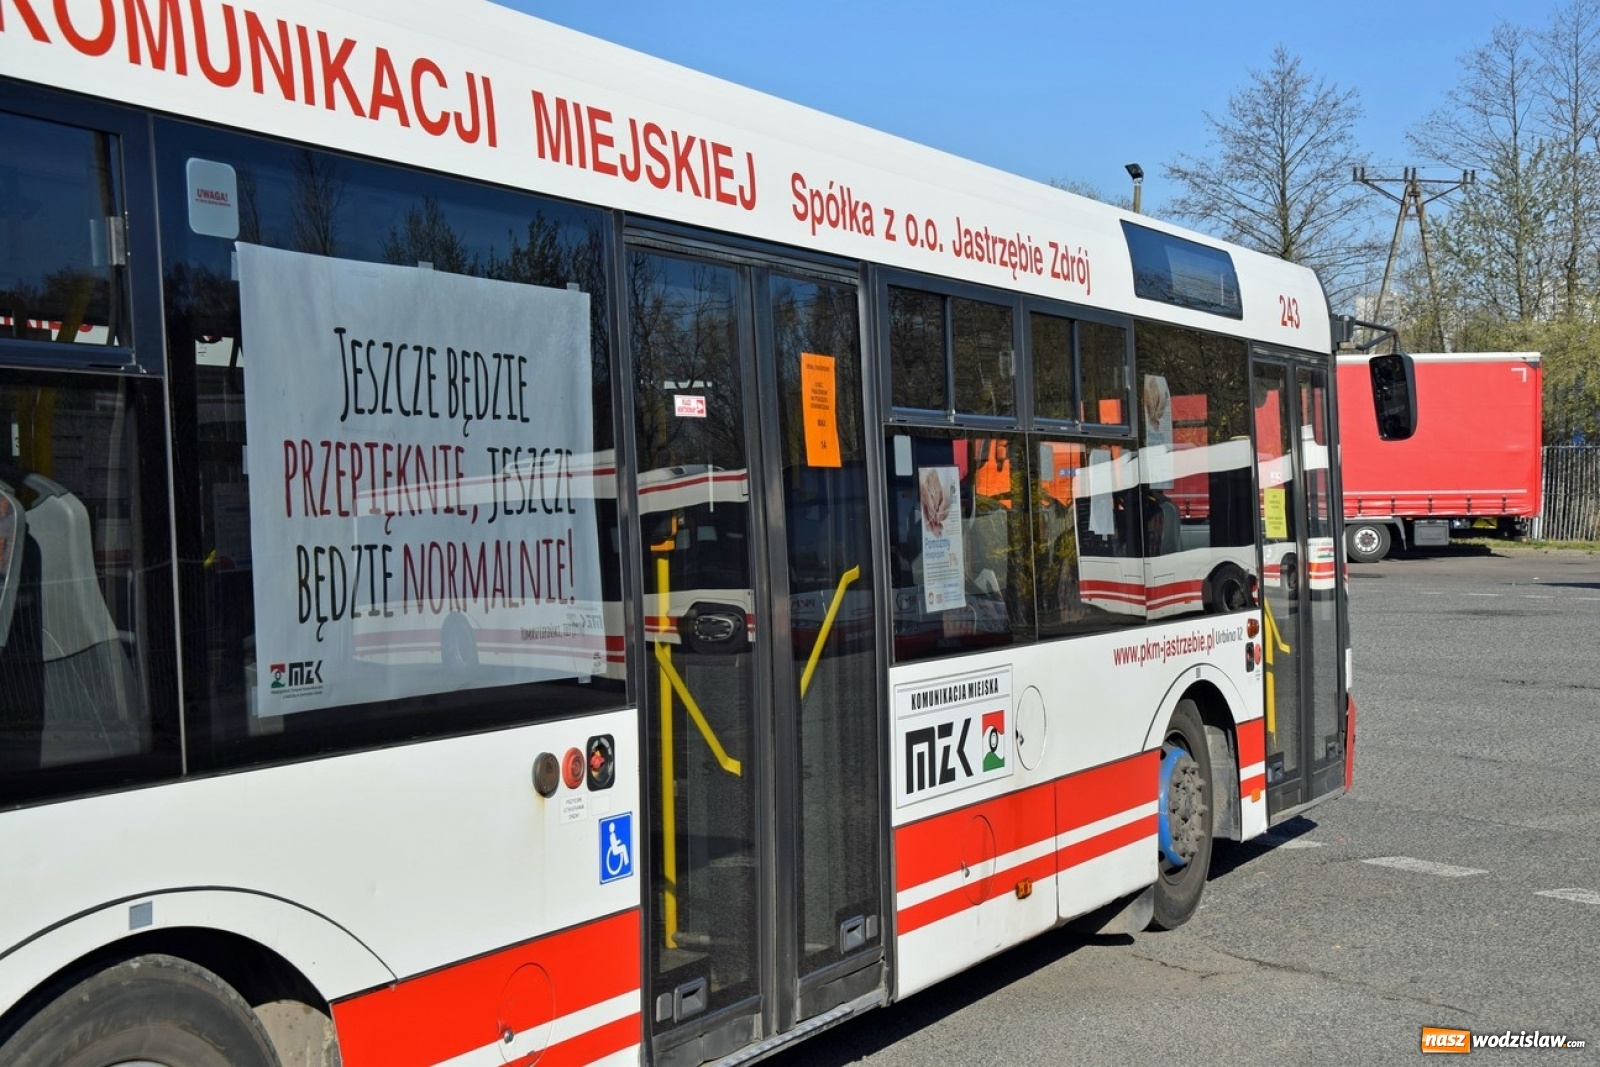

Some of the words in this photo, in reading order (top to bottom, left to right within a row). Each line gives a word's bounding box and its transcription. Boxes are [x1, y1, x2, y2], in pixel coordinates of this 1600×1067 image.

[196, 188, 229, 202] UWAGA!
[532, 90, 756, 210] MIEJSKIEJ
[791, 172, 875, 236] Spółka
[884, 208, 897, 242] z
[905, 214, 944, 253] o.o.
[953, 217, 1043, 281] Jastrzębie
[1049, 241, 1091, 296] Zdrój
[1279, 294, 1301, 330] 243
[333, 327, 439, 422] JESZCZE
[447, 346, 531, 437] BĘDZIE
[283, 439, 479, 535] PRZEPIĘKNIE,
[487, 447, 577, 524] JESZCZE
[297, 544, 394, 642] BĘDZIE
[403, 529, 576, 616] NORMALNIE!
[1113, 627, 1216, 668] www.pkm-jastrzebie.pl
[1215, 629, 1236, 645] Urbino
[1237, 626, 1244, 641] 12
[288, 659, 324, 687] MZK
[911, 684, 967, 711] KOMUNIKACJA
[968, 677, 999, 699] MIEJSKA
[905, 717, 974, 795] MZK
